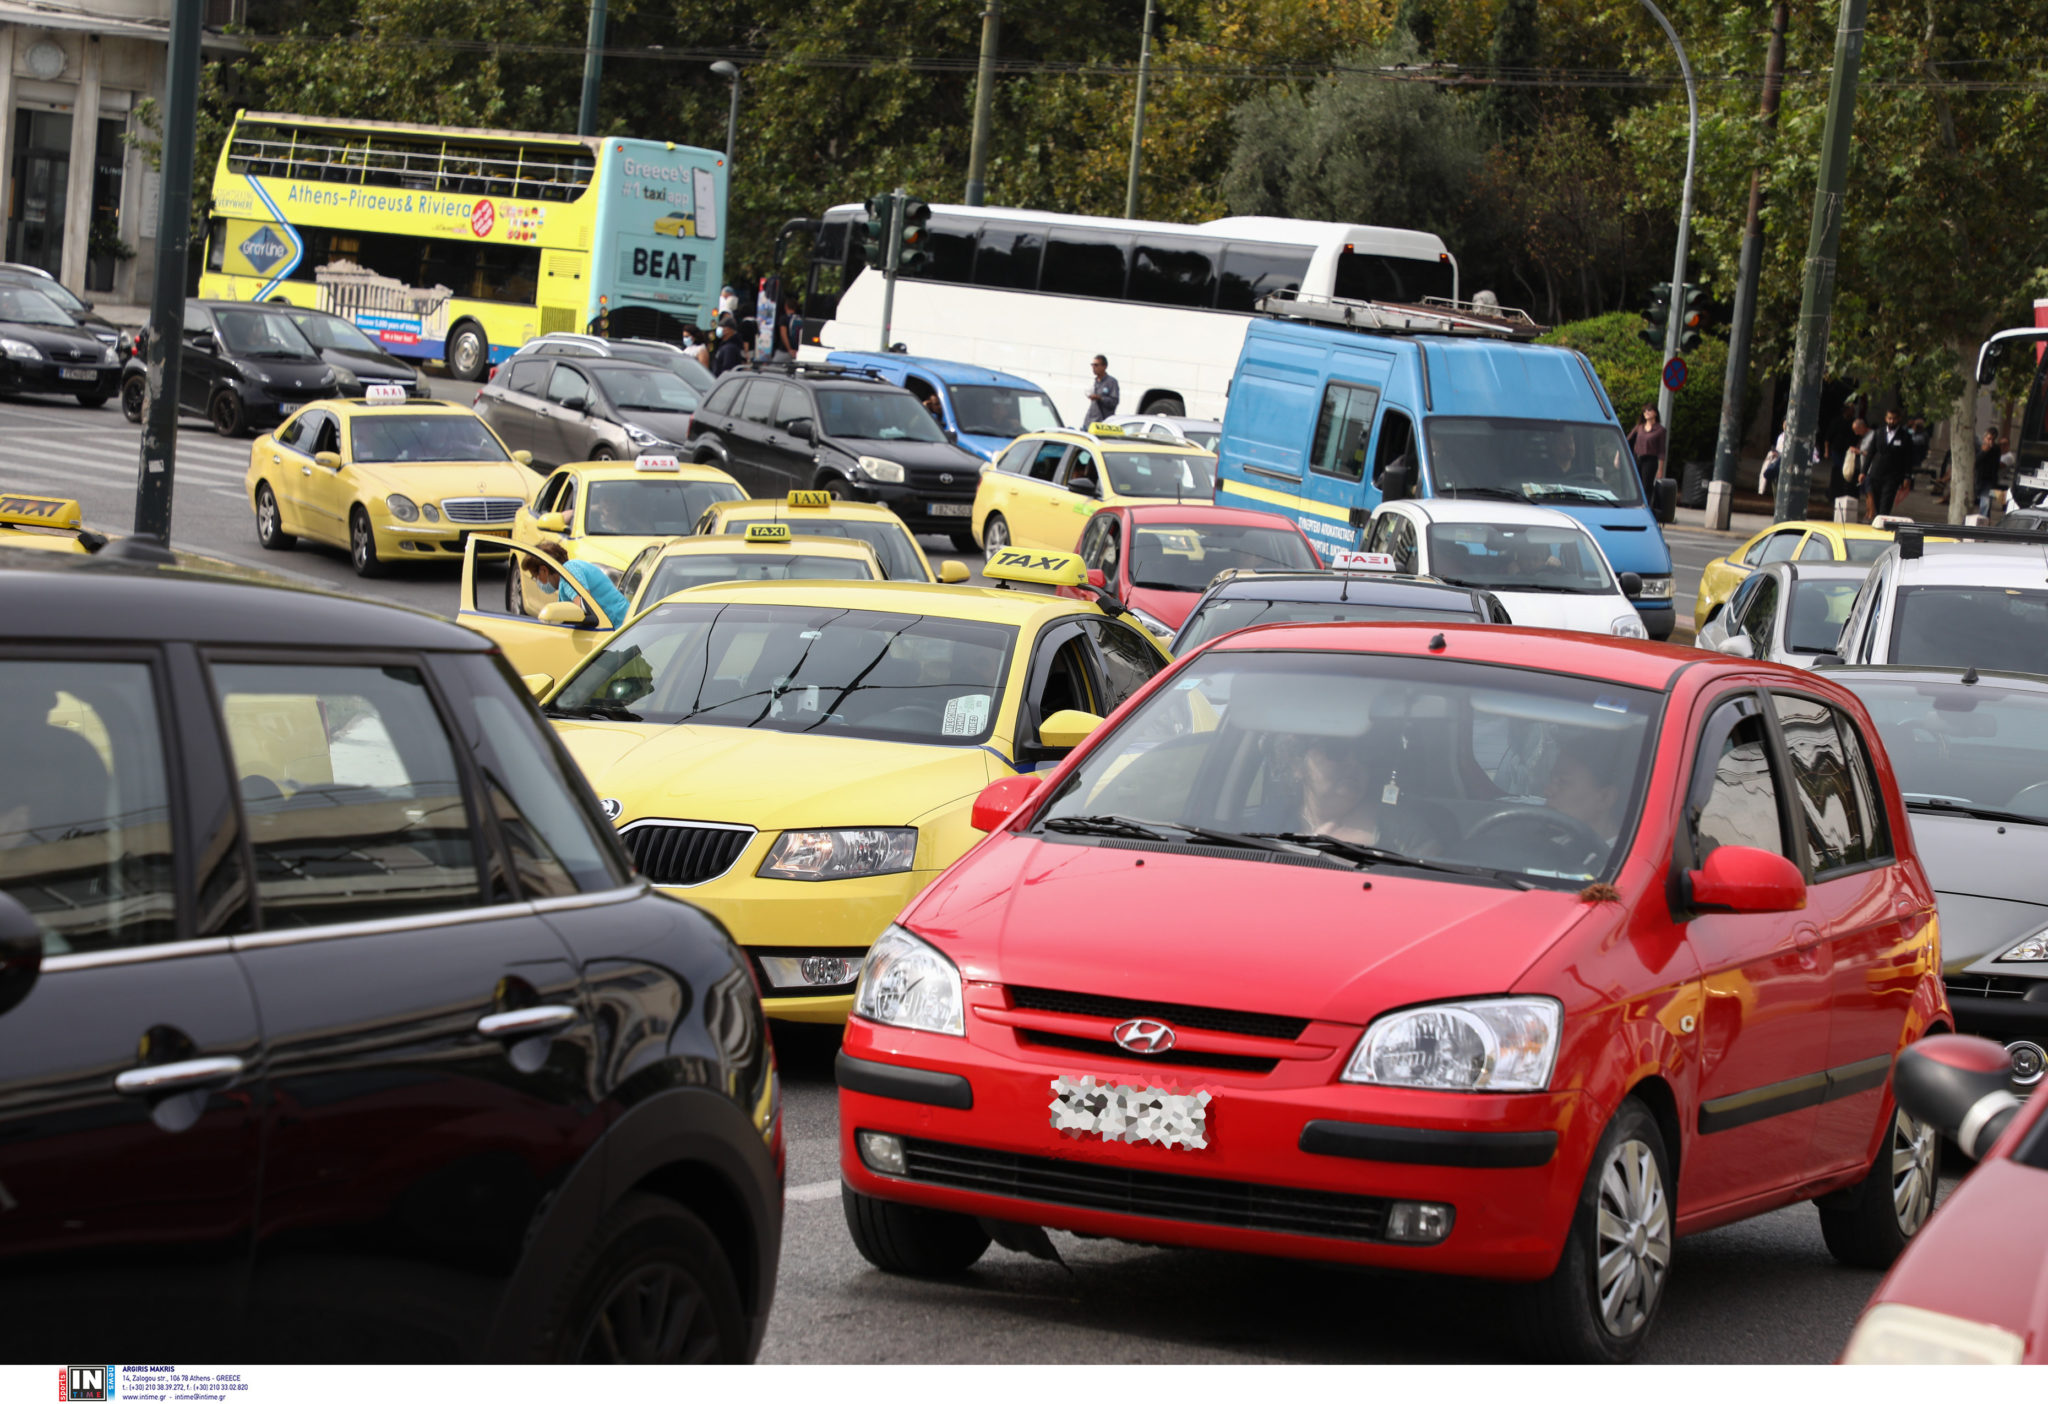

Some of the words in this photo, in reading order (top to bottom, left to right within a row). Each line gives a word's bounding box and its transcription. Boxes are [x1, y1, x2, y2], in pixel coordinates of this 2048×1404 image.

[624, 158, 690, 184] Greece's
[418, 195, 472, 218] Riviera
[643, 186, 667, 201] taxi
[667, 192, 689, 208] app
[633, 247, 697, 282] BEAT
[0, 497, 66, 517] TAXI
[792, 492, 828, 505] TAXI
[753, 528, 784, 536] TAXI
[997, 553, 1070, 570] TAXI
